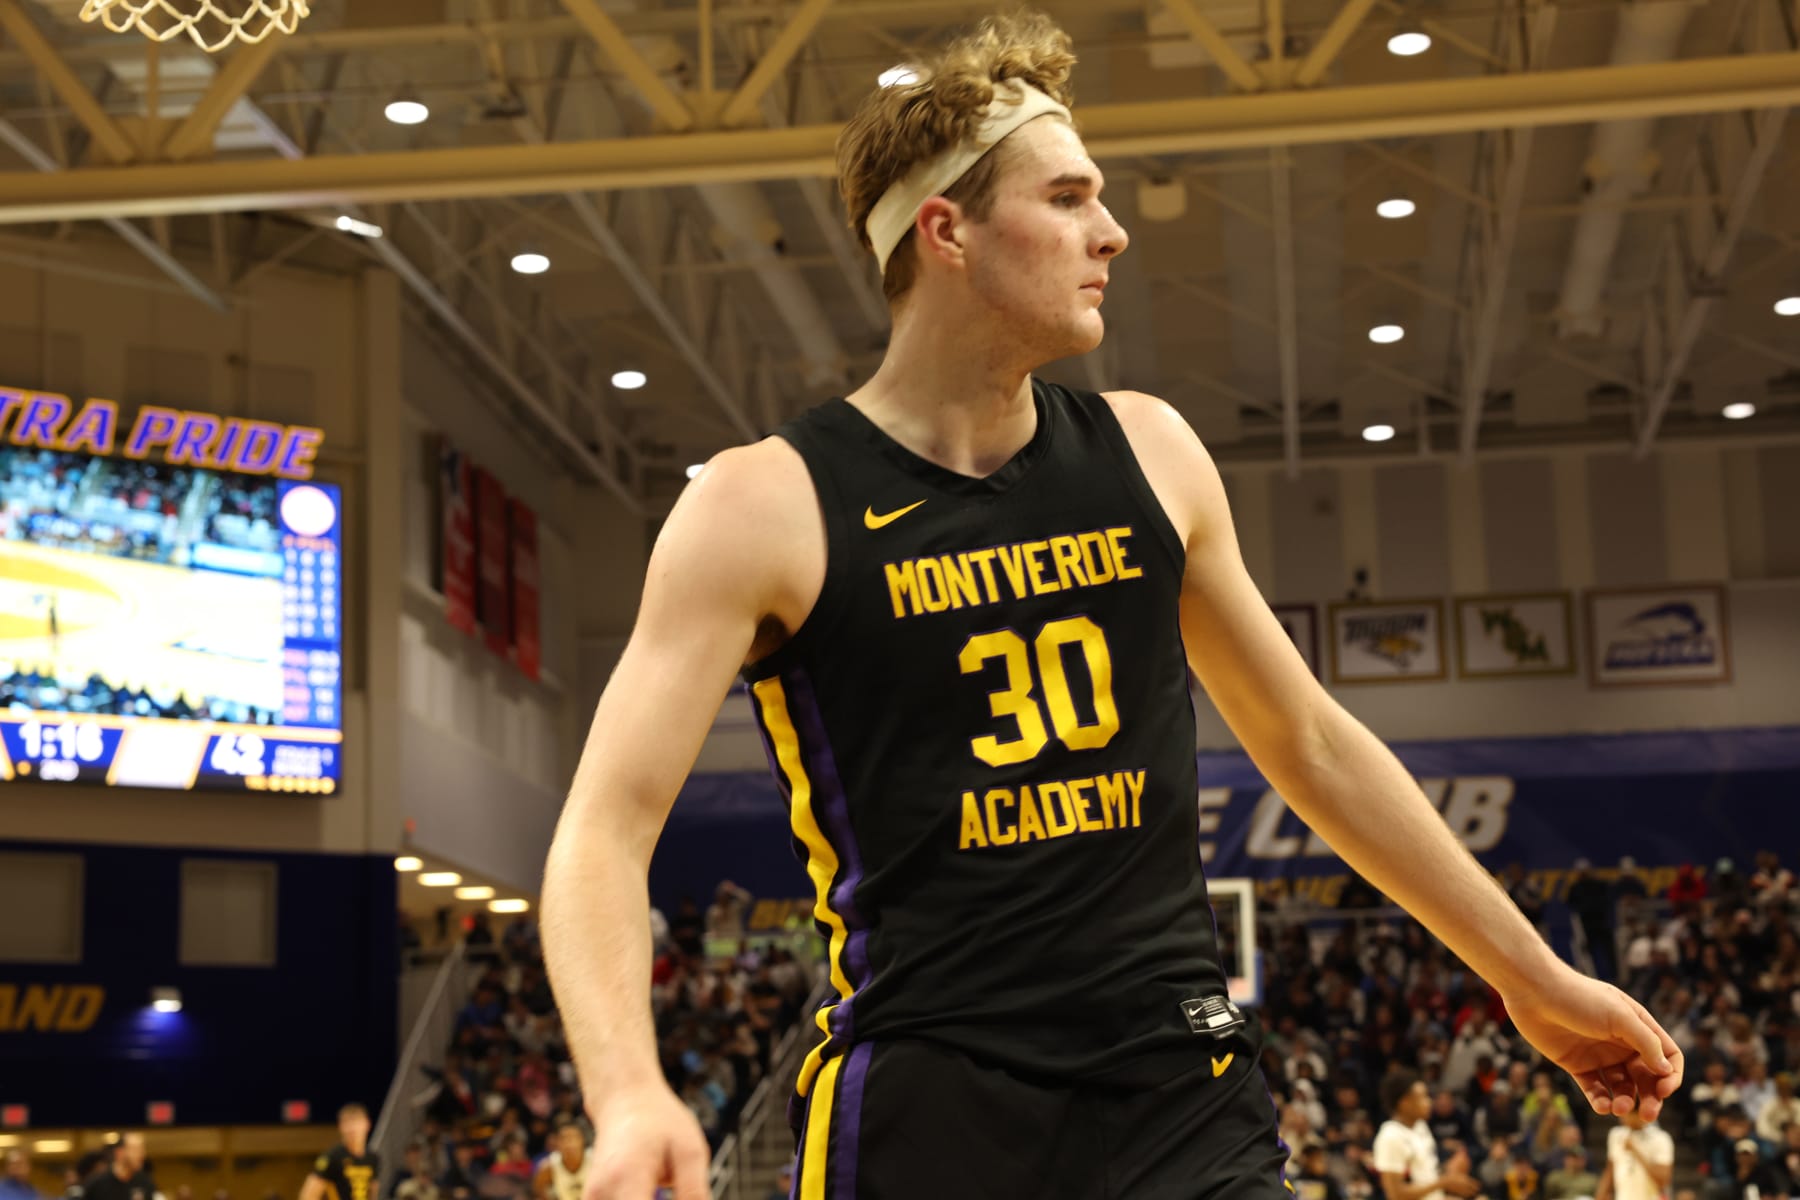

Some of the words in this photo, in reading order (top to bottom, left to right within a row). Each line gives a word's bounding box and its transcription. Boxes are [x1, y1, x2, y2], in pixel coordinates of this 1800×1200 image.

[124, 405, 325, 480] PRIDE
[883, 526, 1143, 619] MONTVERDE
[957, 614, 1120, 768] 30
[210, 732, 266, 775] 42
[958, 768, 1146, 850] ACADEMY
[1246, 776, 1514, 860] CB
